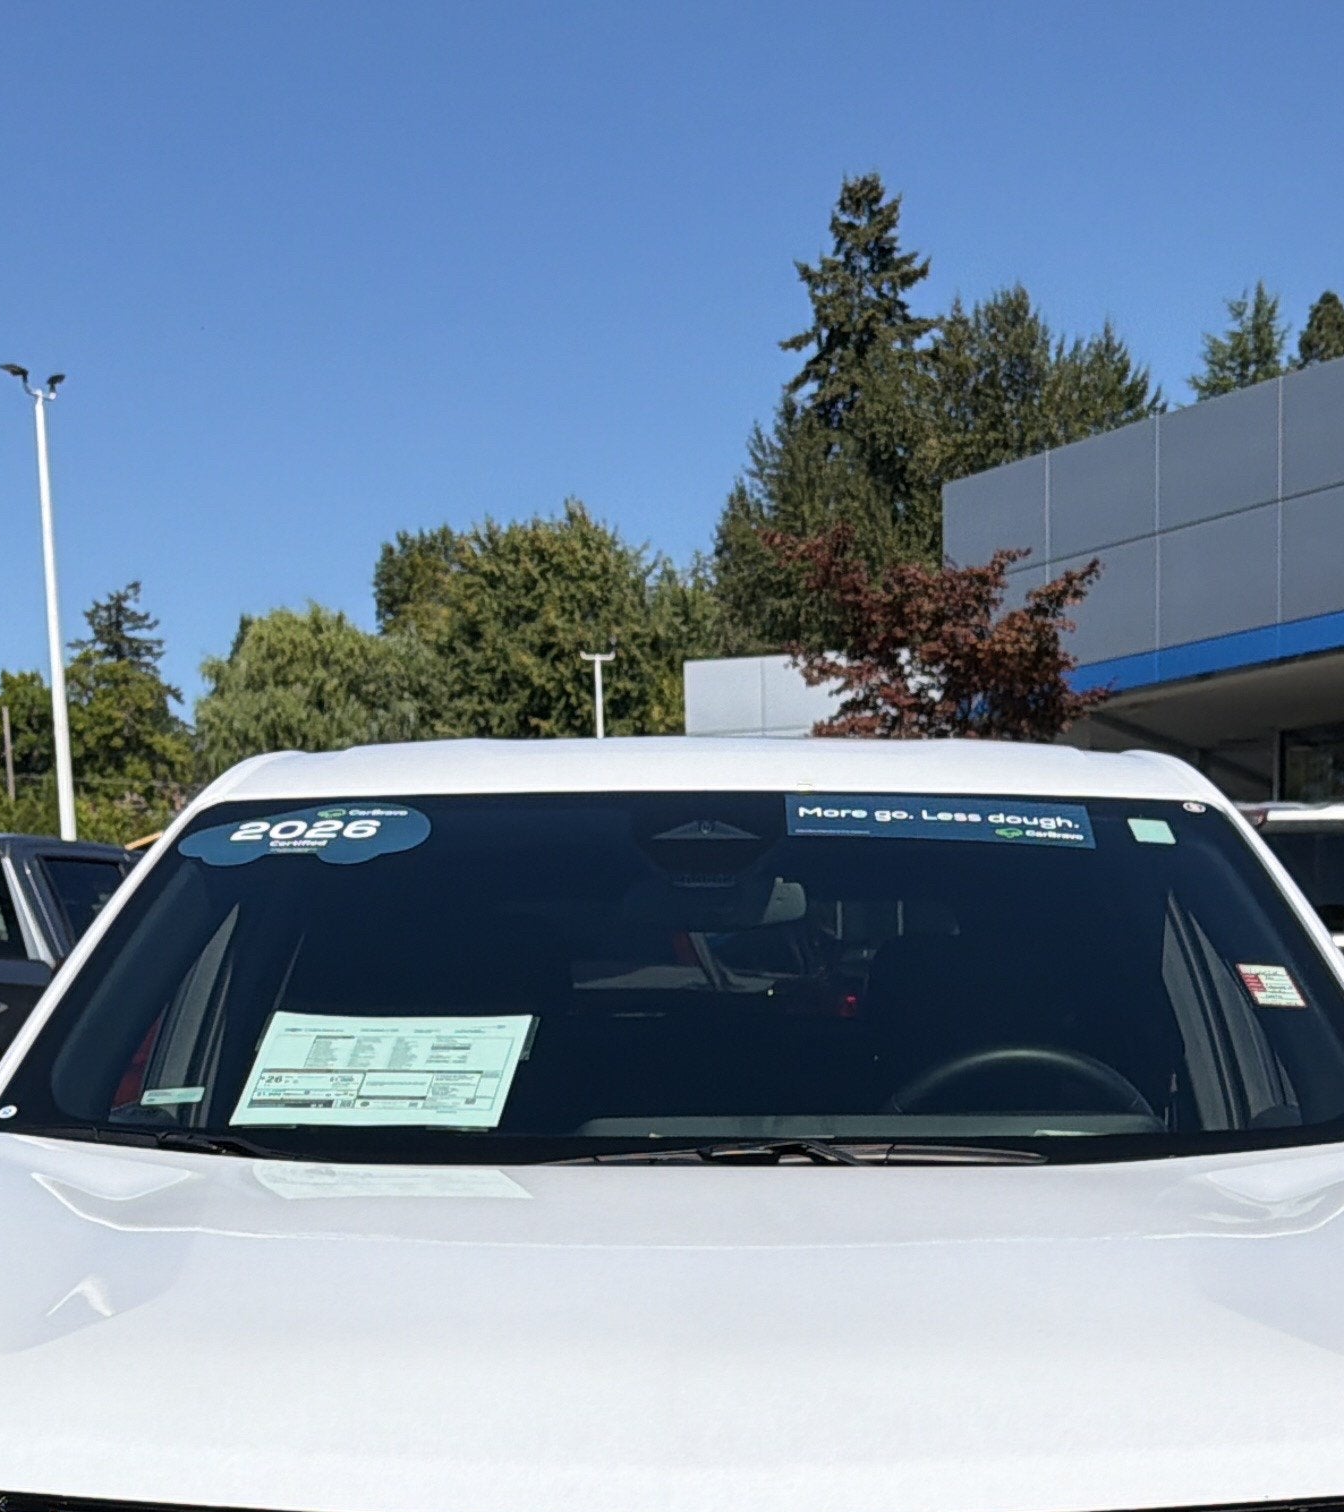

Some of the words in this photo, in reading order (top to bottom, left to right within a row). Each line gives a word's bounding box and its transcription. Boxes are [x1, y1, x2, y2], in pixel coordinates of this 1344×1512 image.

[798, 805, 868, 819] More
[874, 809, 914, 821] go.
[922, 809, 982, 823] Less
[987, 813, 1080, 831] dough.
[230, 820, 381, 841] 2026
